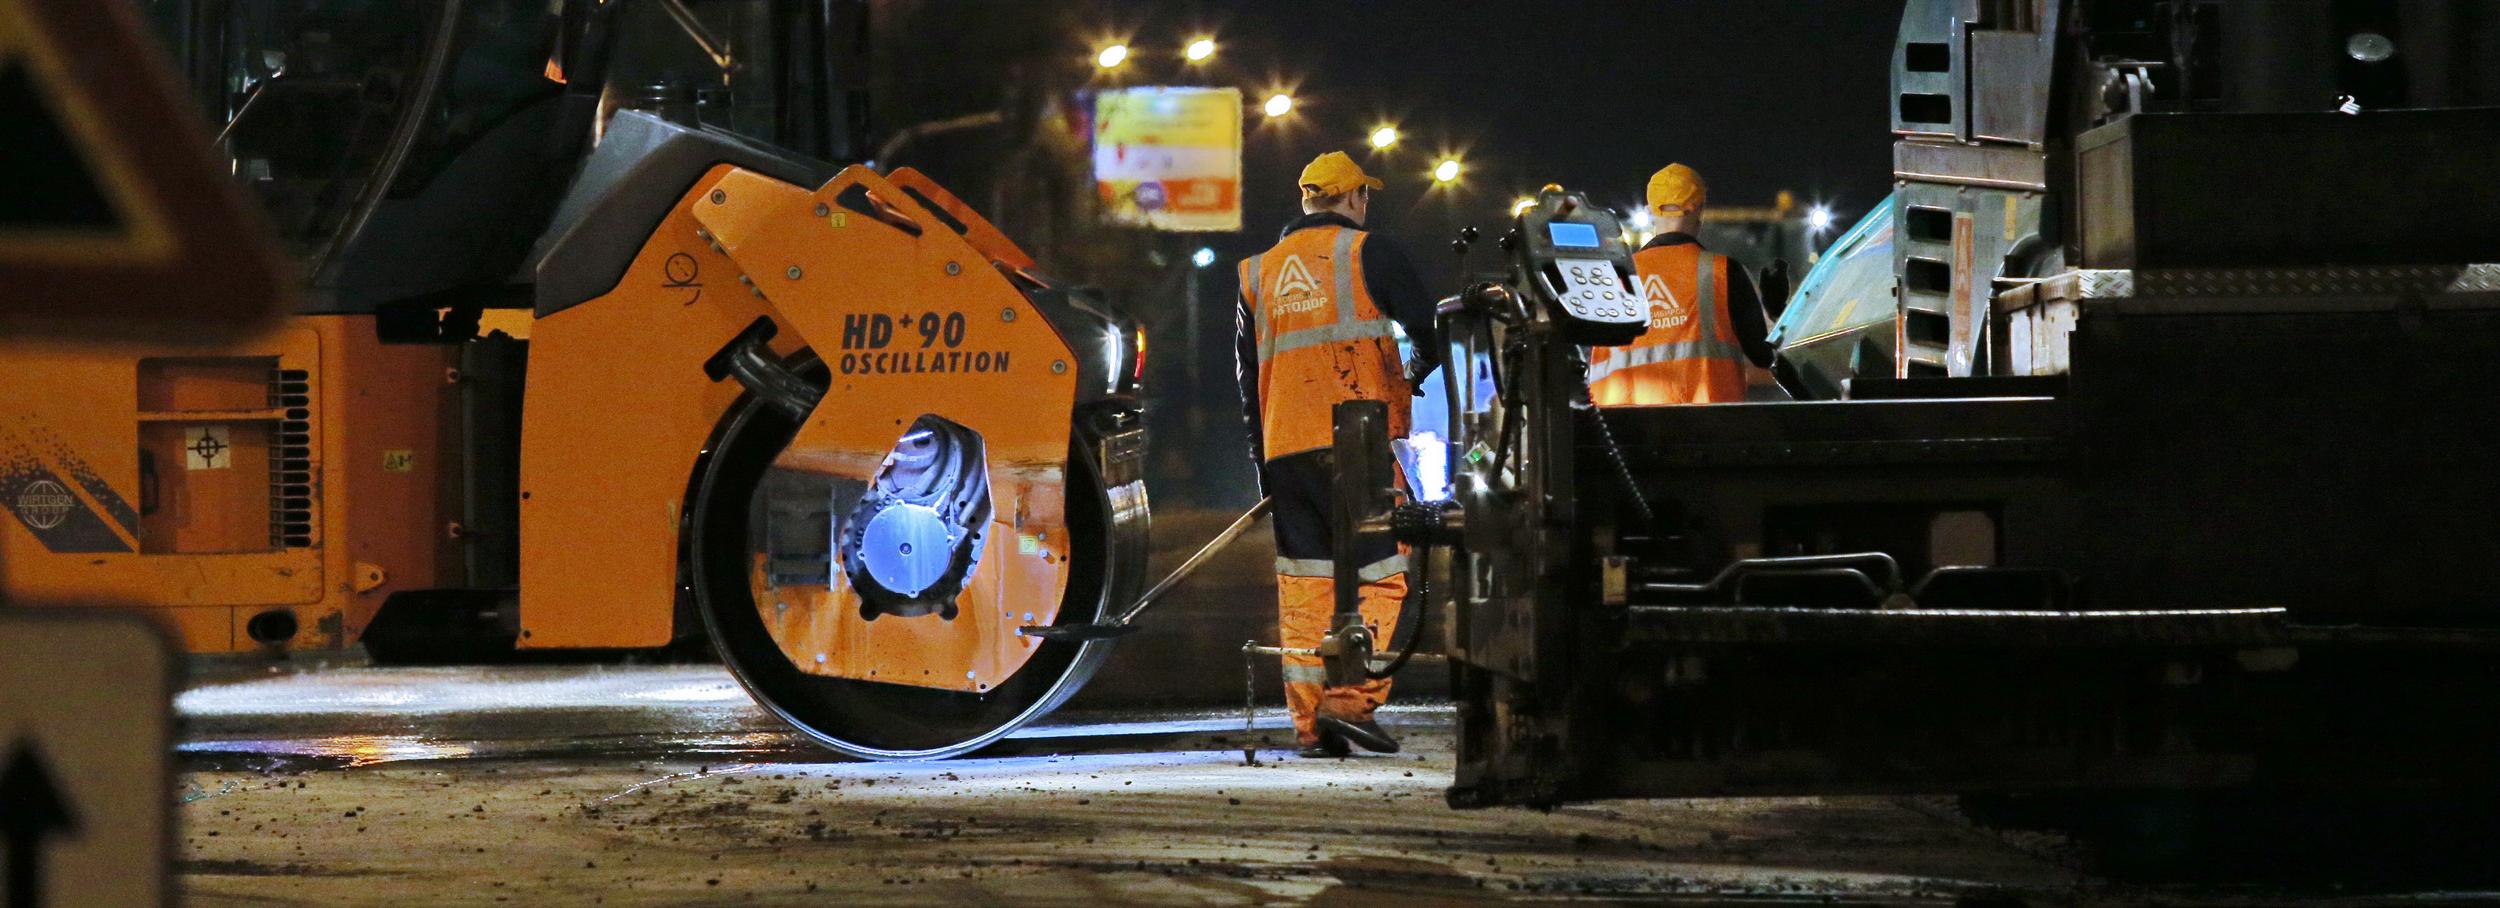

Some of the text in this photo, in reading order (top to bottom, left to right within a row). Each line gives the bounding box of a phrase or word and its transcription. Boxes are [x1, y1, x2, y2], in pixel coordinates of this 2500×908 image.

[1651, 315, 1688, 328] ОДОР
[840, 352, 1010, 375] OSCILLATION
[18, 494, 73, 505] WIRTGEN
